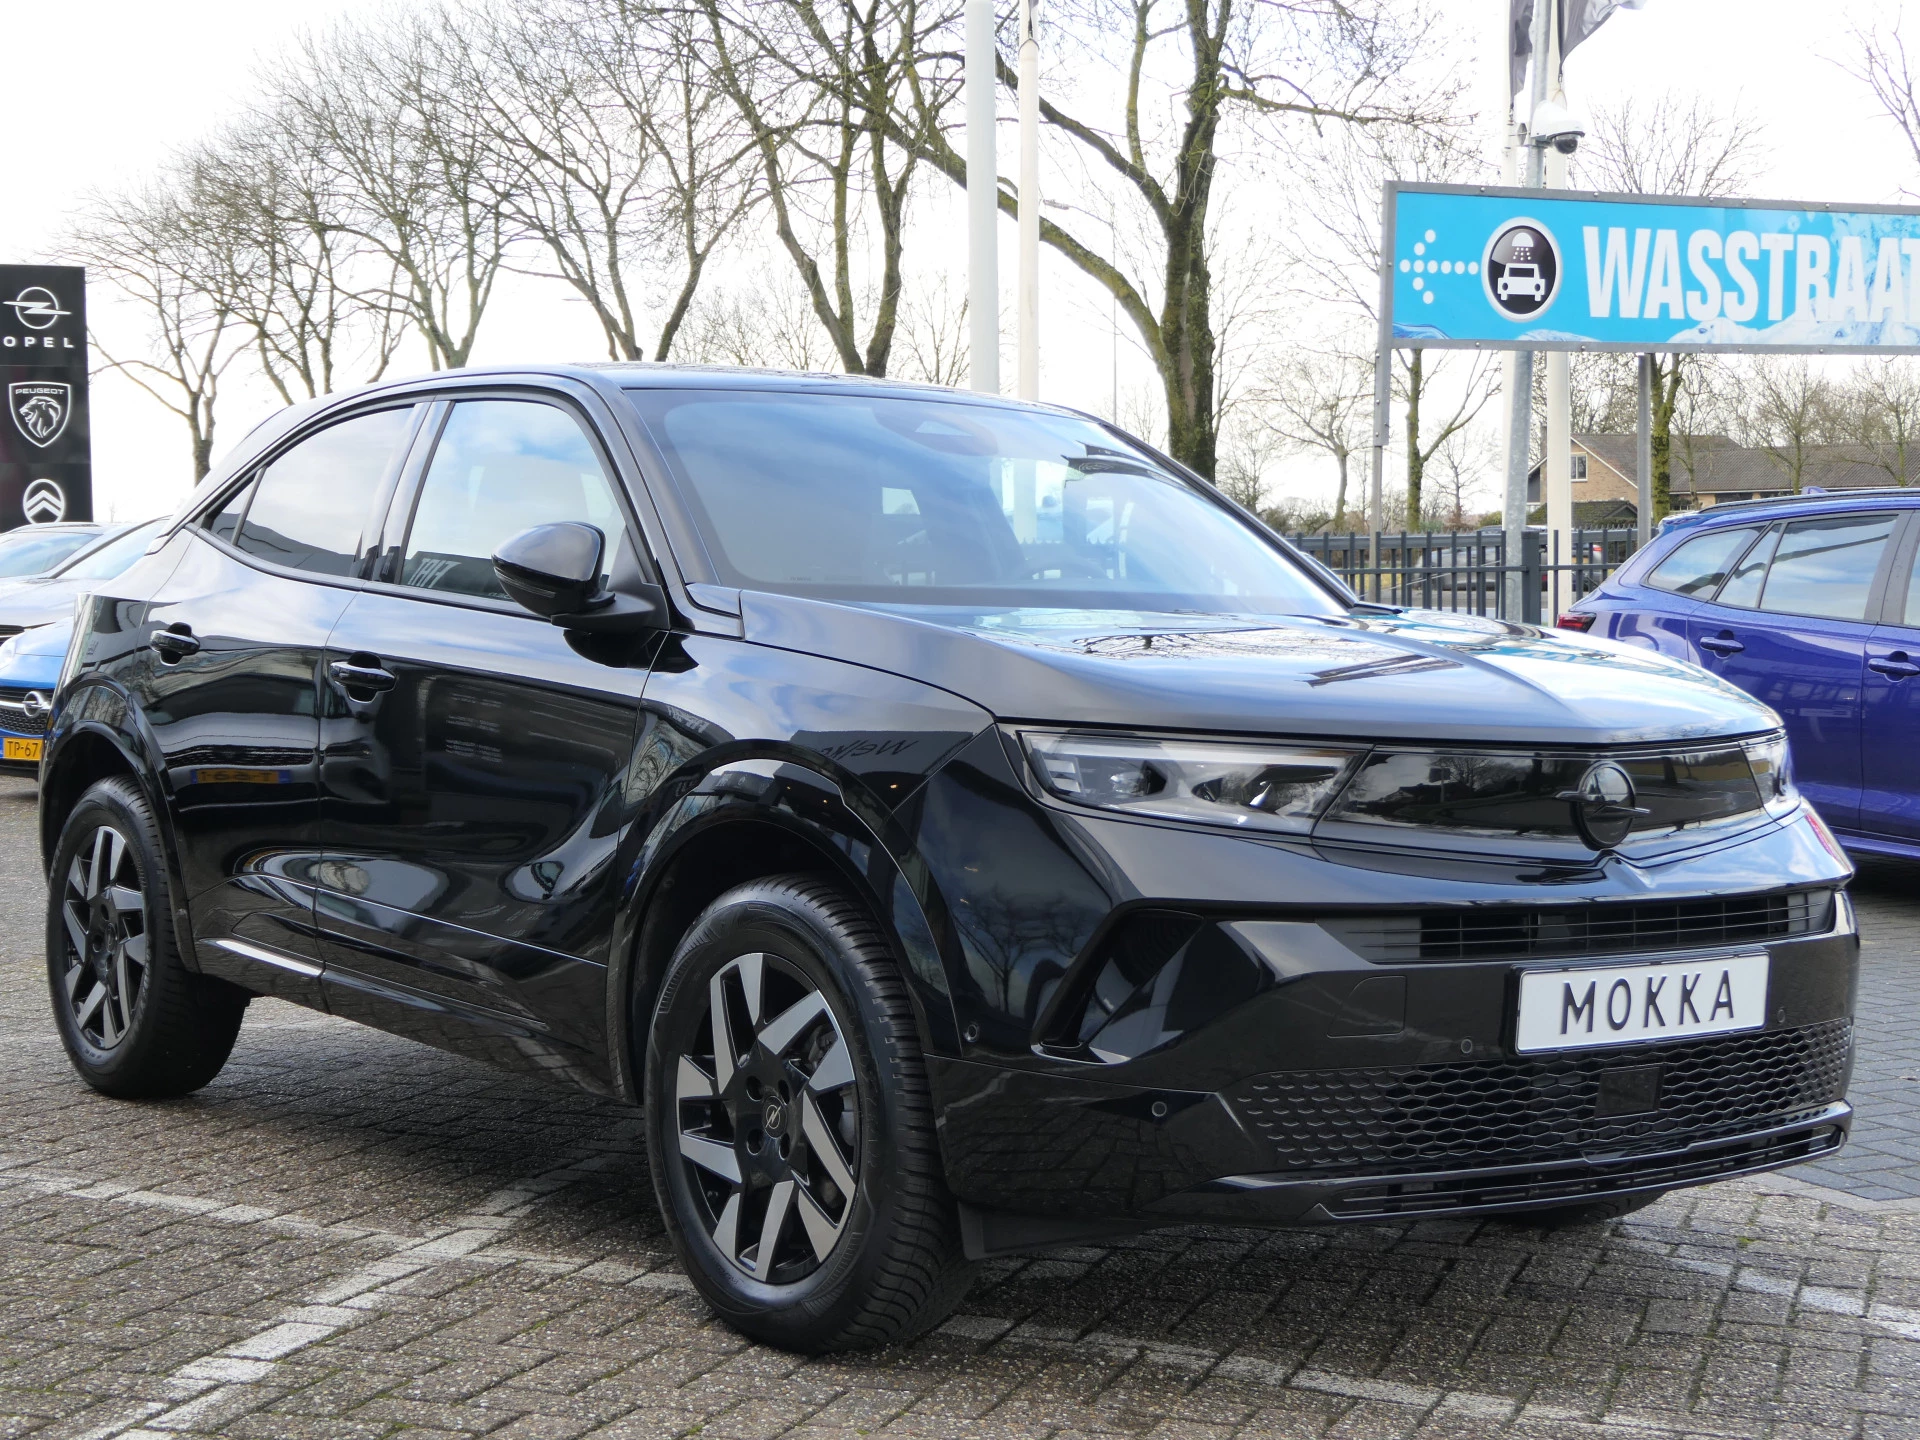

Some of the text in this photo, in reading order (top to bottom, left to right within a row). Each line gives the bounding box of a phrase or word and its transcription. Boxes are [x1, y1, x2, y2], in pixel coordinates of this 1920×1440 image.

[3, 335, 75, 348] OPEL
[15, 387, 65, 395] PEUGEOT
[7, 740, 39, 757] TP-67
[1560, 969, 1734, 1034] MOKKA
